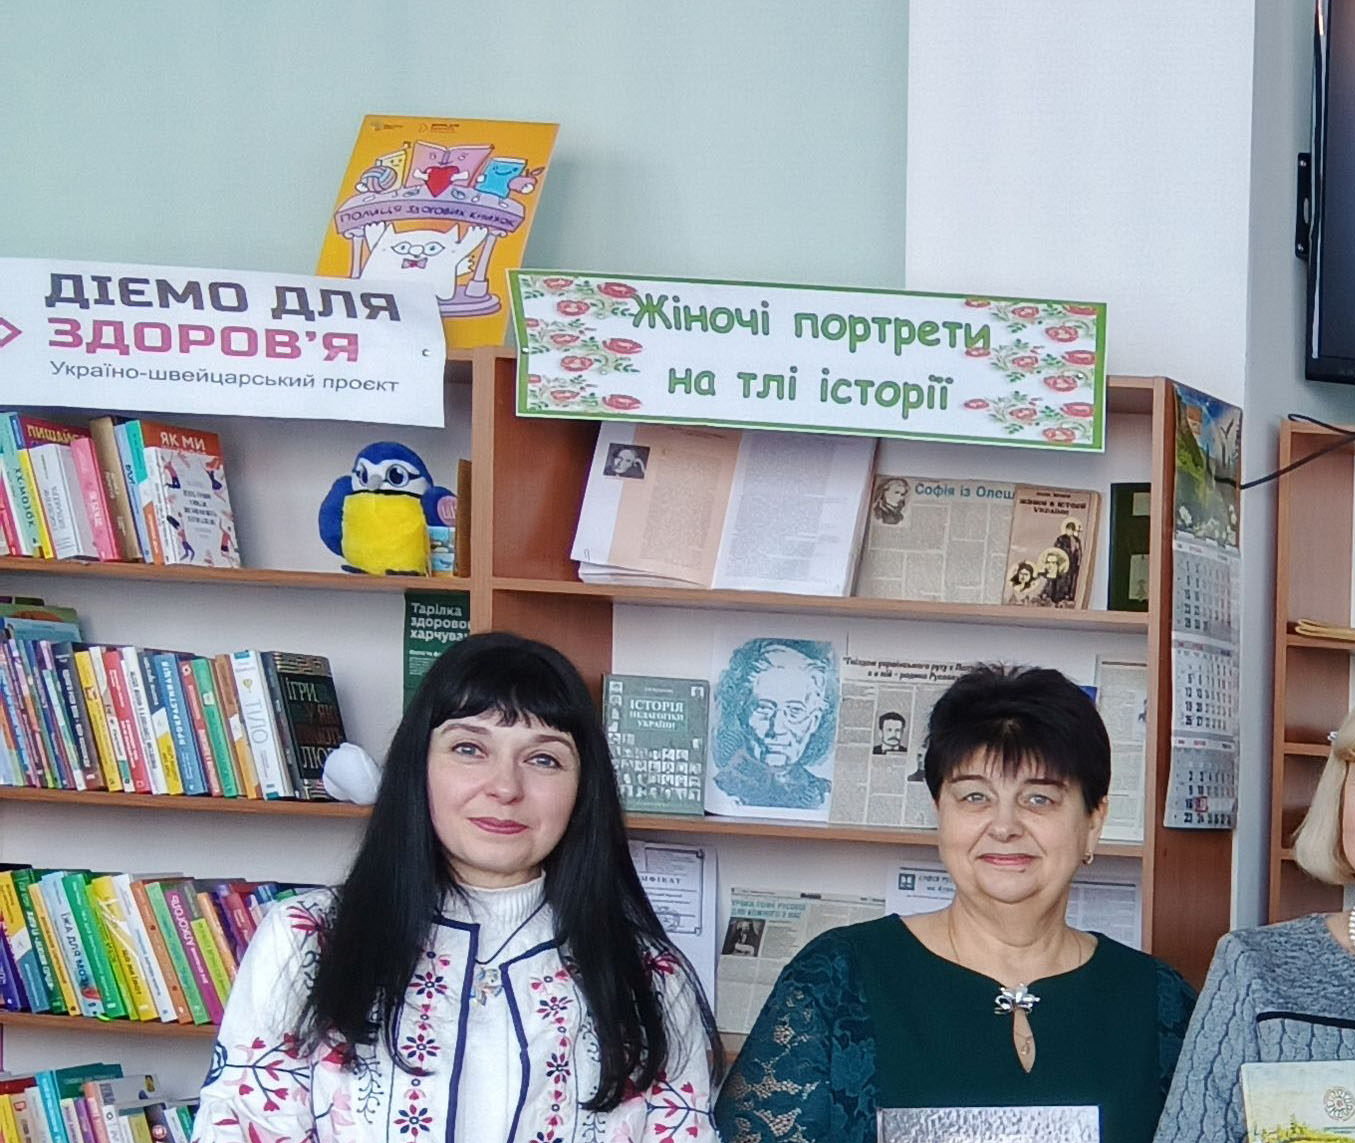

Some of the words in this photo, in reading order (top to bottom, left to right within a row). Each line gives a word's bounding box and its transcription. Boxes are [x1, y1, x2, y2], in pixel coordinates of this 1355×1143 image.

[45, 272, 249, 313] ДІЄМО
[271, 285, 401, 322] ДЛЯ
[633, 293, 770, 336] Жіночі
[794, 312, 991, 356] портрети
[50, 360, 315, 390] Україно-швейцарський
[323, 377, 400, 394] проєкт
[668, 367, 716, 397] на
[737, 366, 798, 401] тлі
[820, 367, 955, 420] історії
[27, 424, 82, 444] ПИШАЙС
[160, 431, 178, 447] ЯК
[181, 435, 206, 451] МИ
[915, 482, 955, 499] Софія
[960, 485, 971, 497] із
[411, 603, 462, 617] Тарілка
[411, 617, 471, 630] здорово
[410, 629, 468, 643] харчува
[629, 699, 684, 713] ІСТОРІЯ
[300, 746, 333, 769] ЛЮ
[641, 876, 682, 885] ИФІКАТ
[170, 894, 195, 946] АЛКОГОЛЬ
